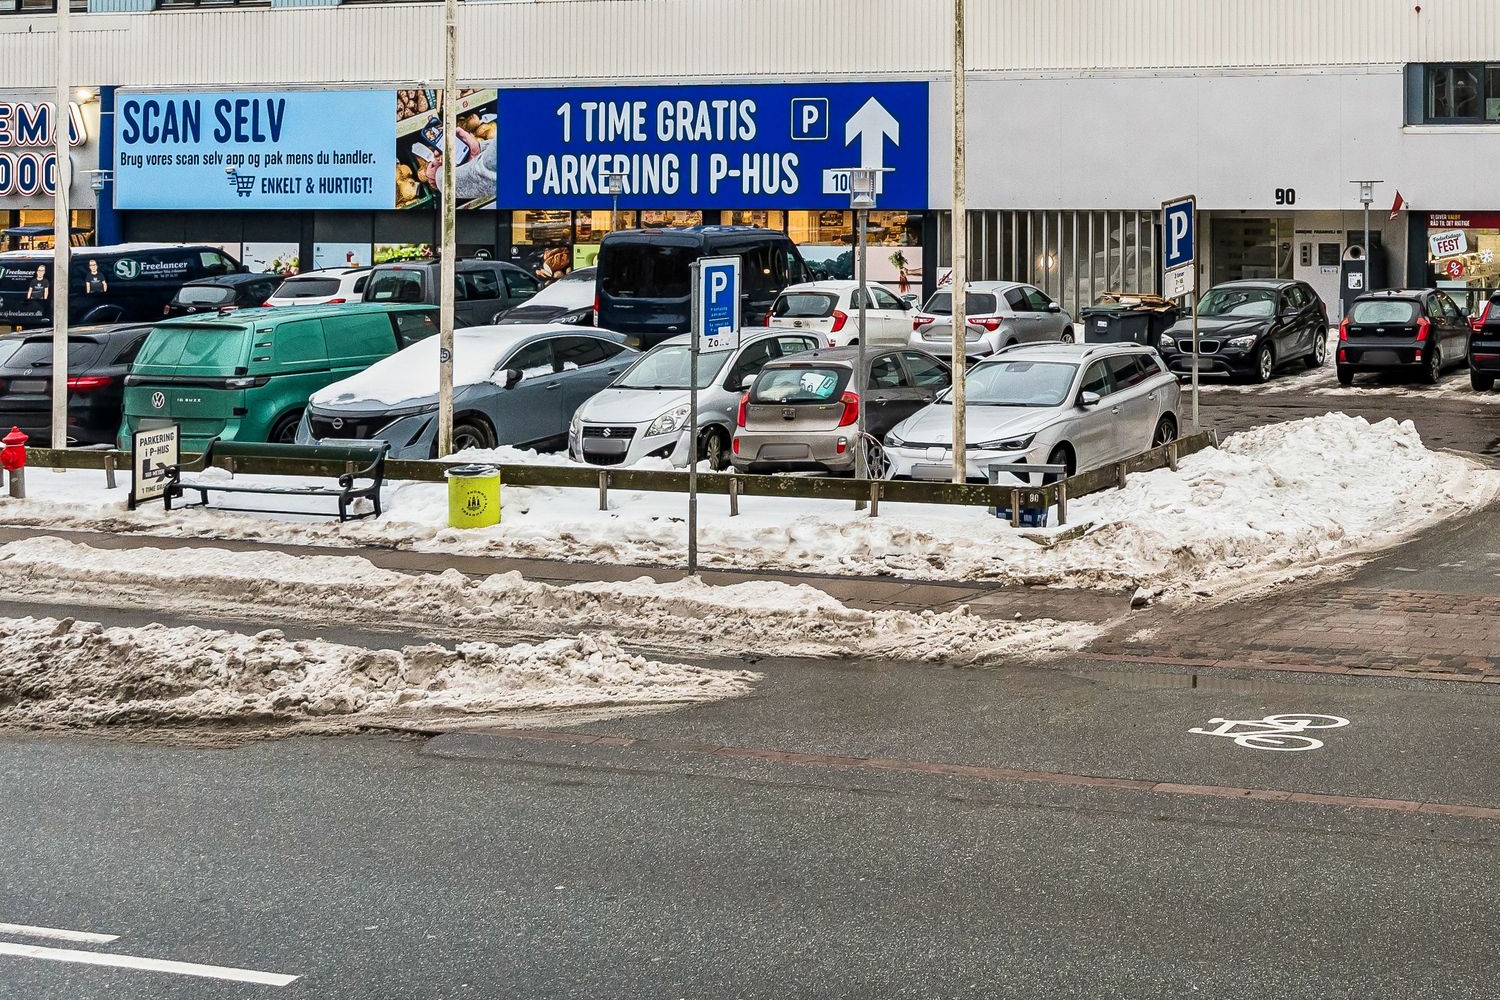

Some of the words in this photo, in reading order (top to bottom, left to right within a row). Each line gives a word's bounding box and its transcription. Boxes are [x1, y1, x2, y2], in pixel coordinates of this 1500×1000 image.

[122, 99, 201, 144] SCAN
[213, 98, 286, 143] SELV
[556, 102, 571, 143] 1
[581, 101, 647, 142] TIME
[656, 99, 757, 141] GRATIS
[120, 152, 143, 169] Brug
[146, 153, 173, 166] vores
[176, 152, 200, 165] scan
[203, 151, 223, 165] selv
[248, 152, 260, 168] og
[264, 151, 283, 168] pak
[286, 151, 314, 165] mens
[317, 151, 330, 165] du
[332, 150, 376, 165] handler.
[526, 153, 679, 195] PARKERING
[710, 152, 799, 194] P-HUS
[261, 177, 302, 194] ENKELT
[305, 177, 315, 194] &
[319, 176, 373, 194] HURTIGT!
[1275, 187, 1296, 206] 90
[1169, 211, 1188, 260] P
[1437, 238, 1459, 253] FEST
[117, 261, 136, 277] SJ
[140, 261, 188, 270] Freelancer
[711, 271, 727, 304] P
[140, 432, 174, 446] PARKERING
[150, 445, 169, 456] P-HUS
